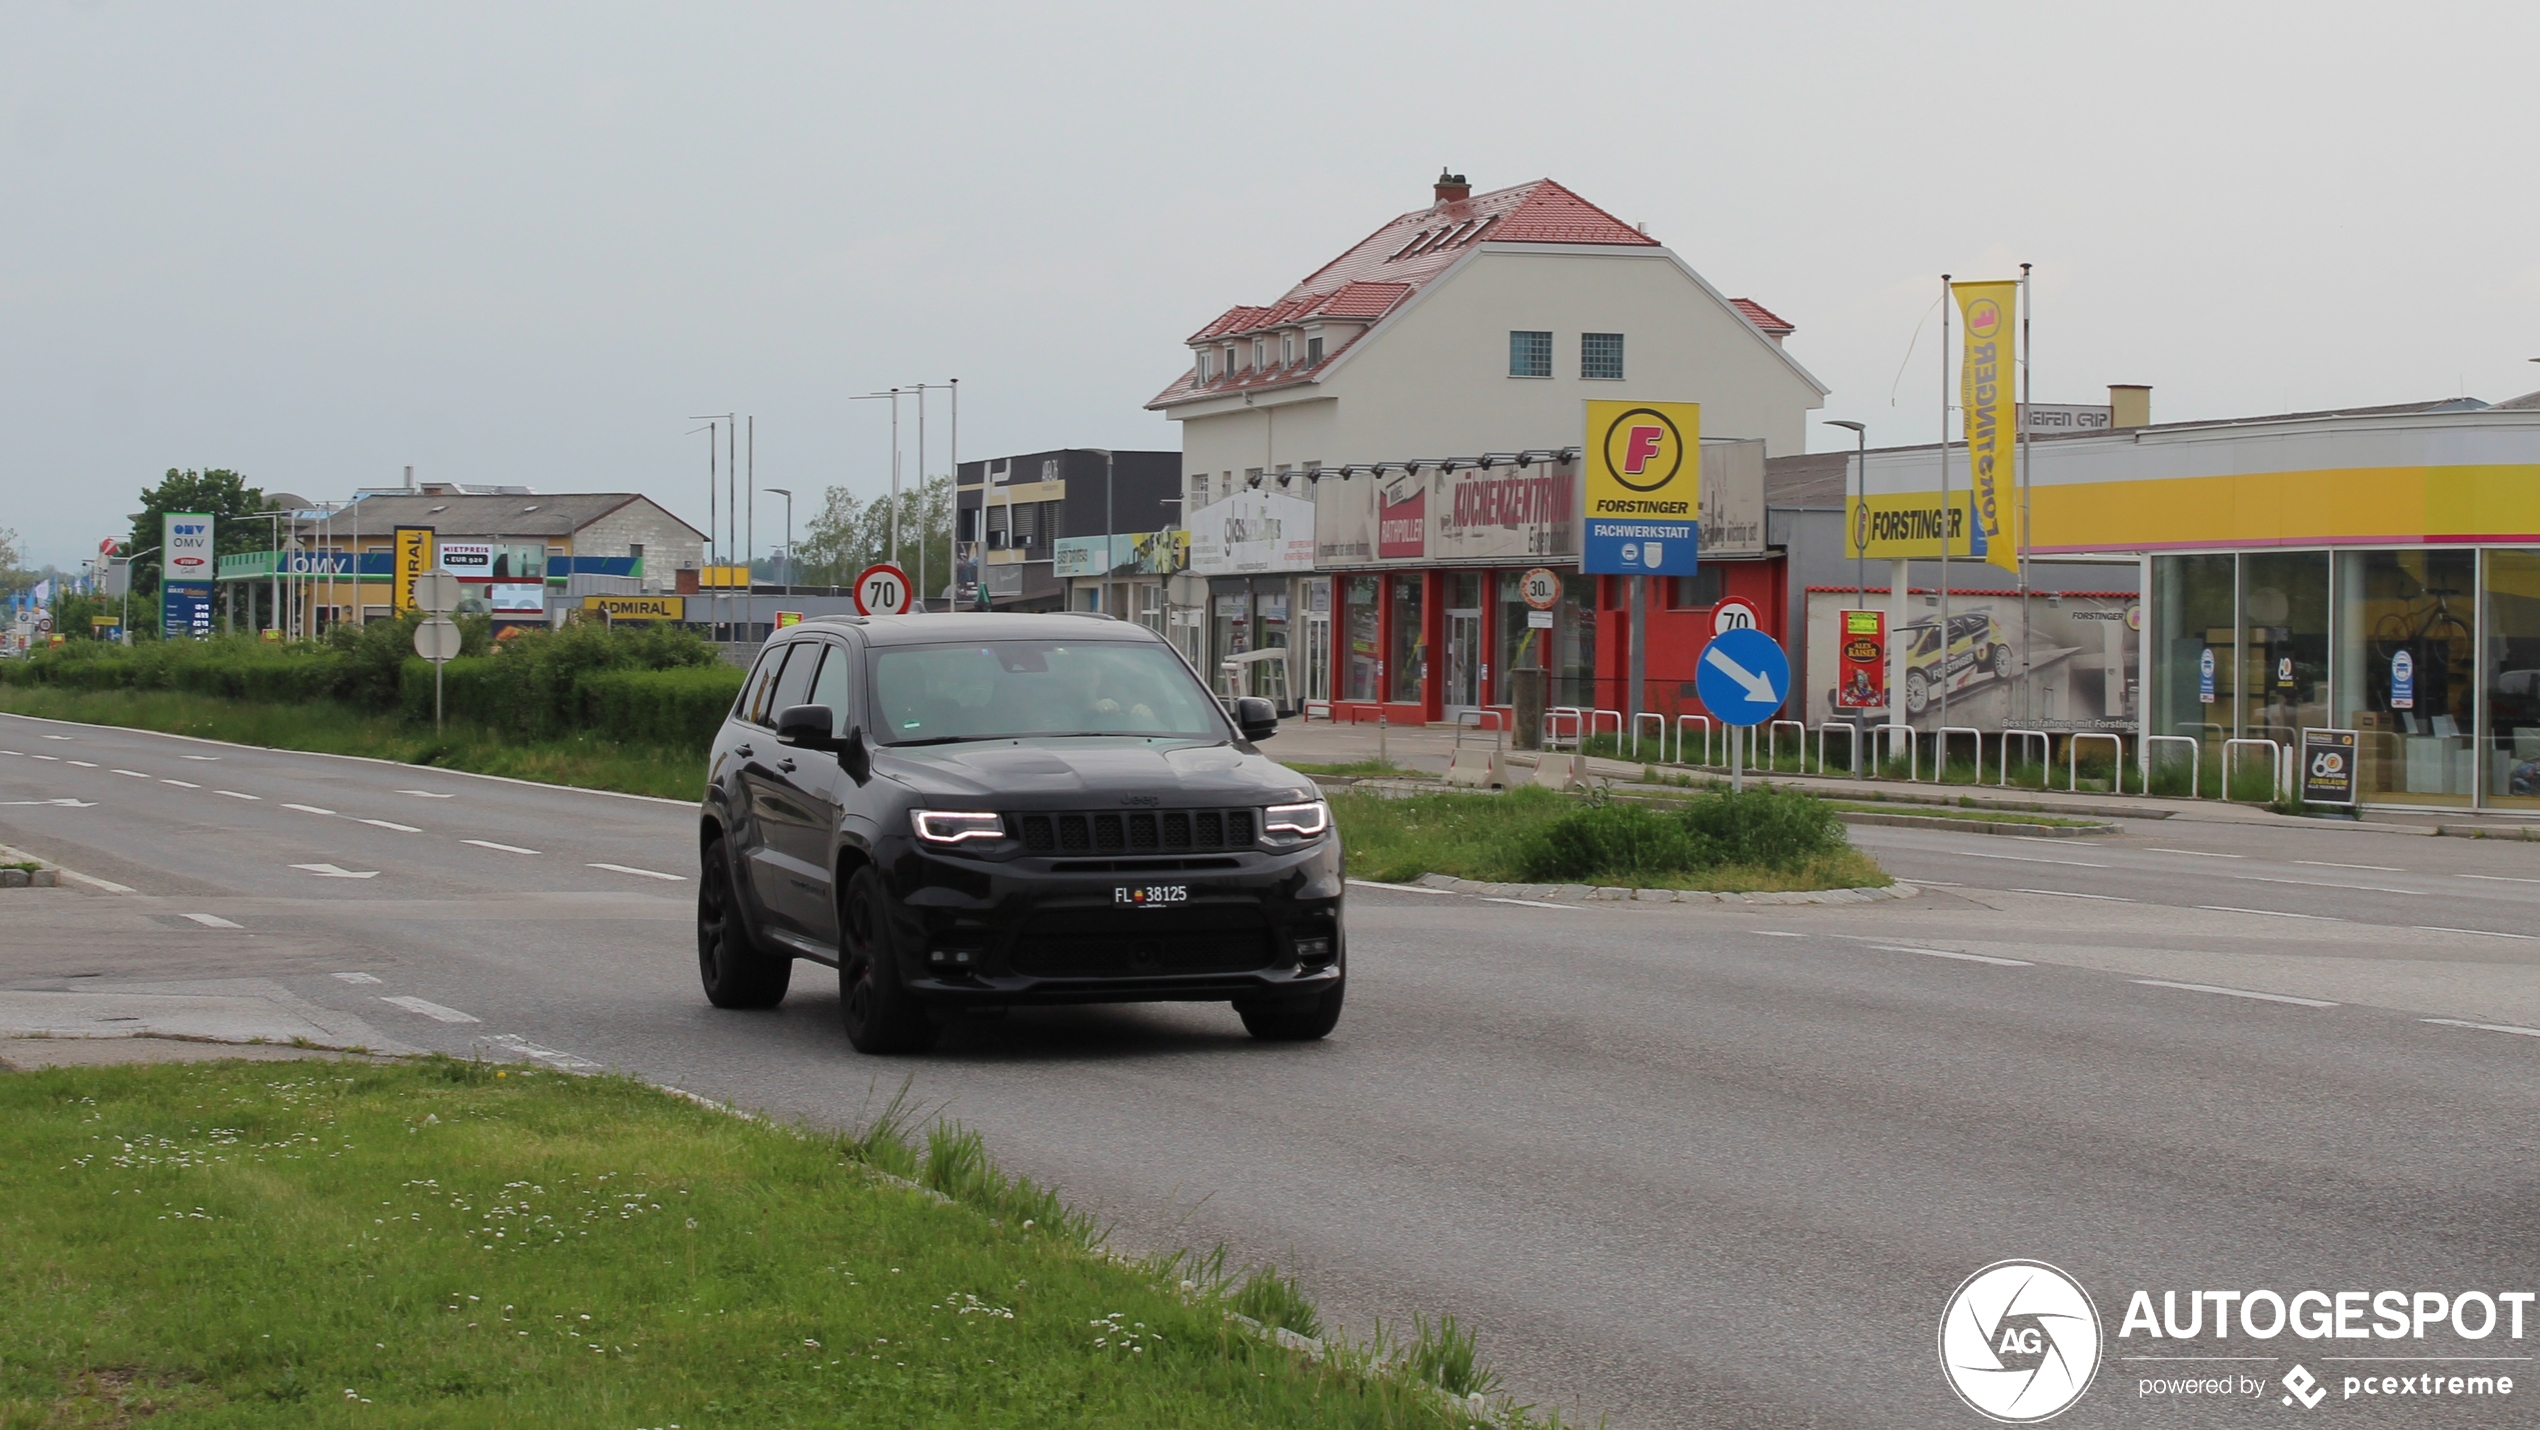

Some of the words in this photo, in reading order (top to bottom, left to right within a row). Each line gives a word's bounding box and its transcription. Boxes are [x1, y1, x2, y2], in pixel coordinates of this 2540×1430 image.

[2077, 412, 2108, 428] GRIP
[1453, 471, 1575, 527] KÜCHENZENTRUM
[1596, 499, 1689, 514] FORSTINGER
[1594, 524, 1690, 538] FACHWERKSTATT
[174, 537, 205, 548] OMV
[293, 557, 347, 573] OMV
[406, 532, 423, 609] DMIRAL
[870, 581, 895, 608] 70
[1530, 580, 1545, 597] 30
[598, 601, 671, 616] ADMIRAL
[2072, 611, 2124, 621] FORSTINGER
[1723, 612, 1748, 629] 70
[1848, 647, 1877, 657] KAISER
[1932, 652, 1974, 681] FOSTINGER
[2076, 719, 2092, 728] mit
[2094, 719, 2140, 729] Forstinge
[2311, 752, 2343, 777] 60
[1121, 792, 1160, 807] Jeep
[1115, 887, 1132, 903] FL
[1145, 885, 1188, 902] 38125
